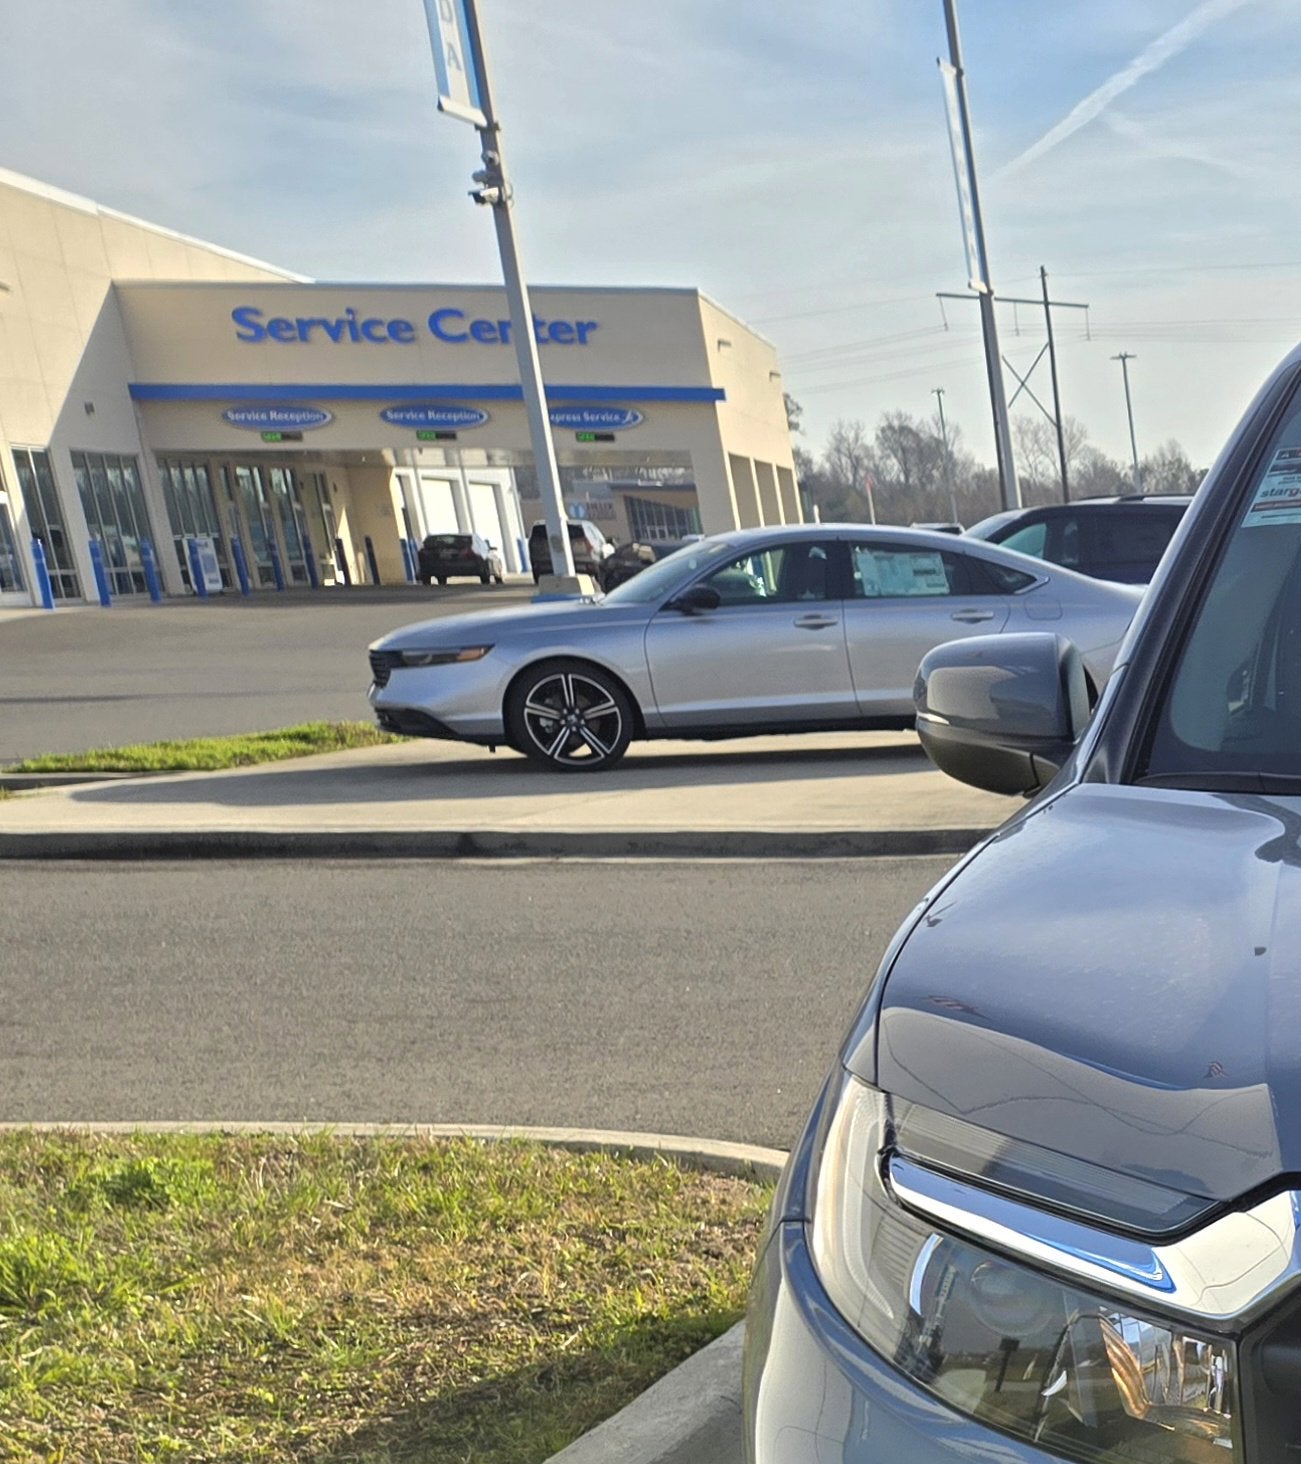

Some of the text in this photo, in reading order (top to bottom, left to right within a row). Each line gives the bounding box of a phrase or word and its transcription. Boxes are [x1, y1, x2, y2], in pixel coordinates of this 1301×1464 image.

[231, 305, 416, 344] Service
[227, 409, 324, 423] Service Reception
[386, 408, 480, 422] Service Reception
[583, 410, 621, 422] Service
